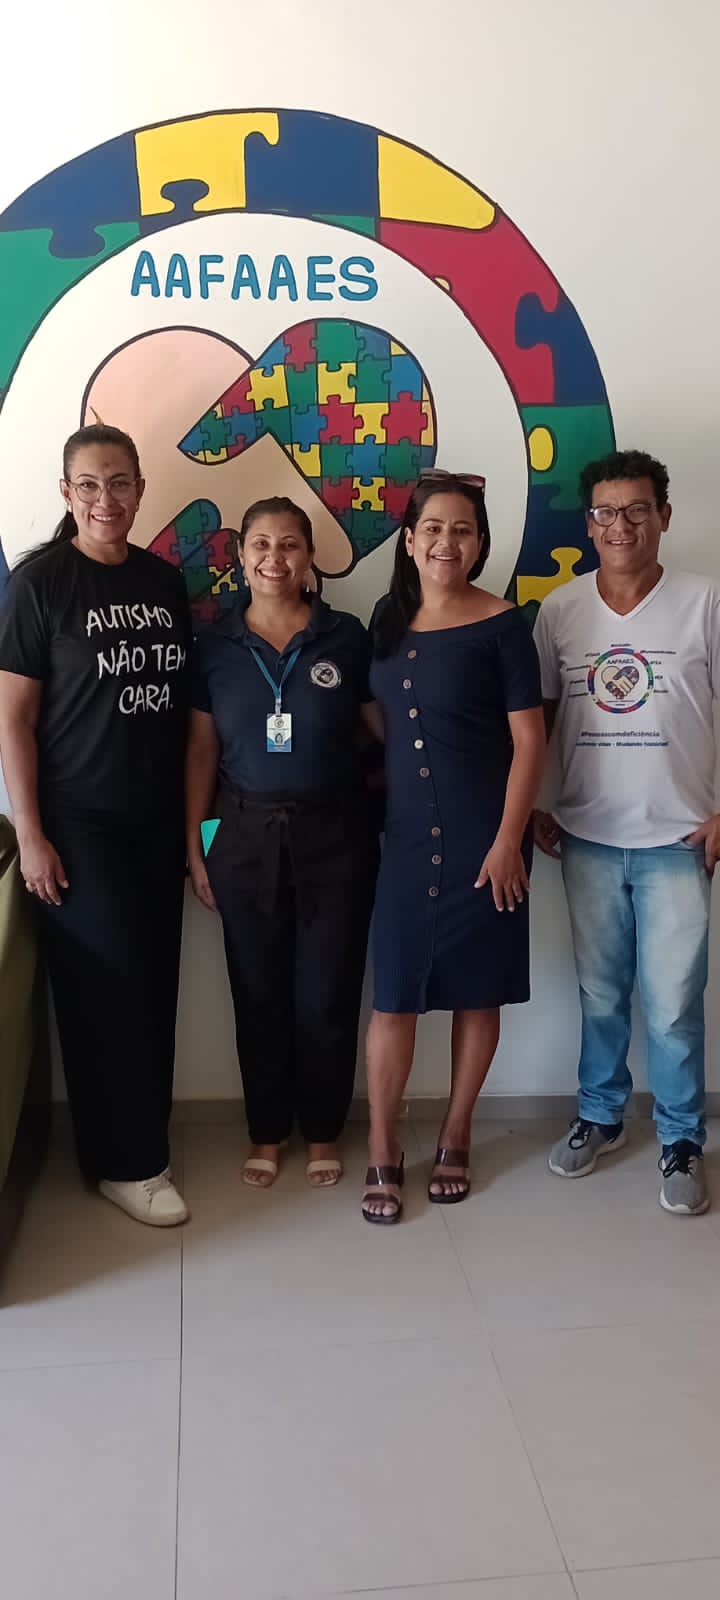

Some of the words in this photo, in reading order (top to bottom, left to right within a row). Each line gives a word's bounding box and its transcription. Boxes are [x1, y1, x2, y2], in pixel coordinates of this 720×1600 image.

[130, 250, 379, 302] AAFAAES
[86, 603, 173, 637] AUTISMO
[97, 640, 146, 680] NÃO
[119, 682, 174, 715] CARA.
